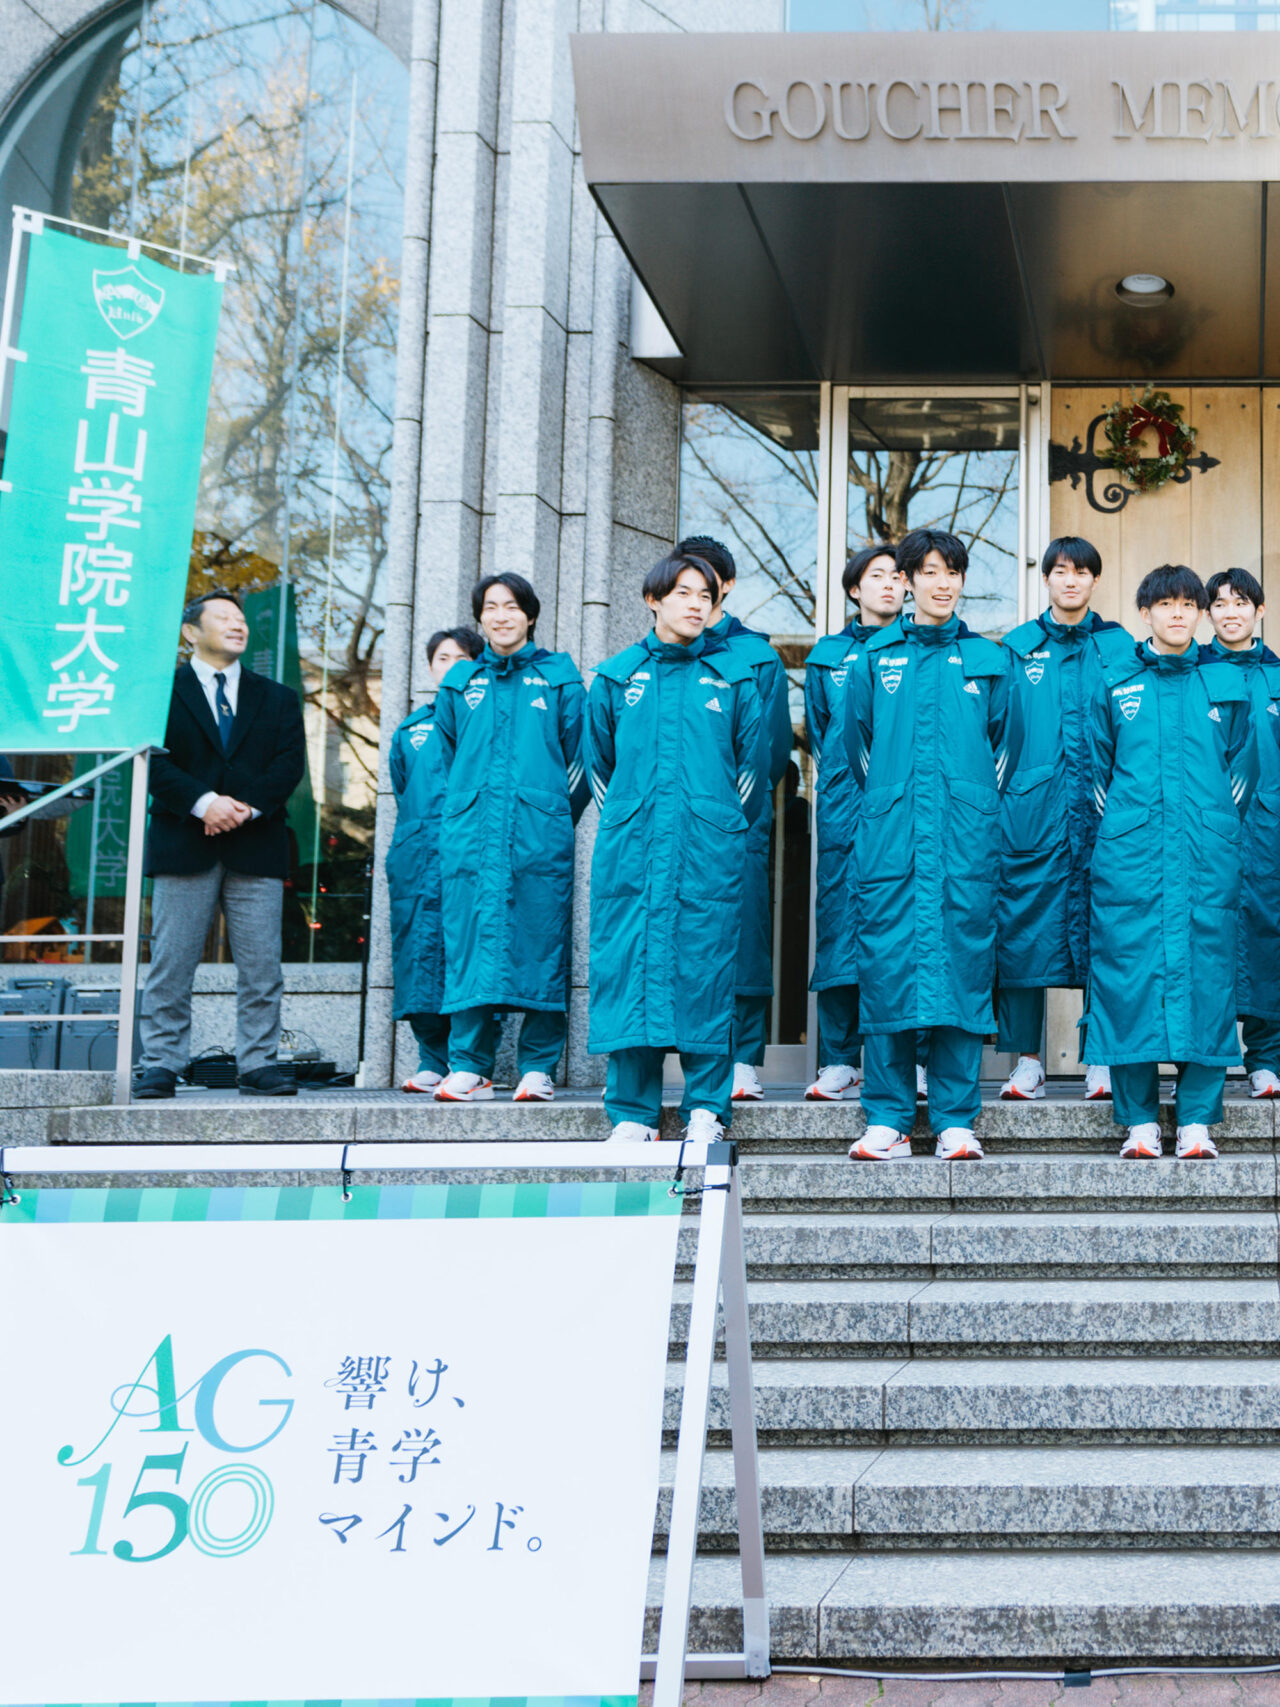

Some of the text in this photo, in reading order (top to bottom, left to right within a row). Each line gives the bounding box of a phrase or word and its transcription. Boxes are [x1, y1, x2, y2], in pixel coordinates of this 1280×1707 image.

[724, 80, 1077, 143] GOUCHER
[43, 347, 156, 733] 青山学院大学
[57, 1334, 295, 1466] AG
[323, 1355, 465, 1411] 響け、
[327, 1427, 442, 1484] 青学
[69, 1441, 275, 1563] 150
[319, 1502, 542, 1552] マインド。
